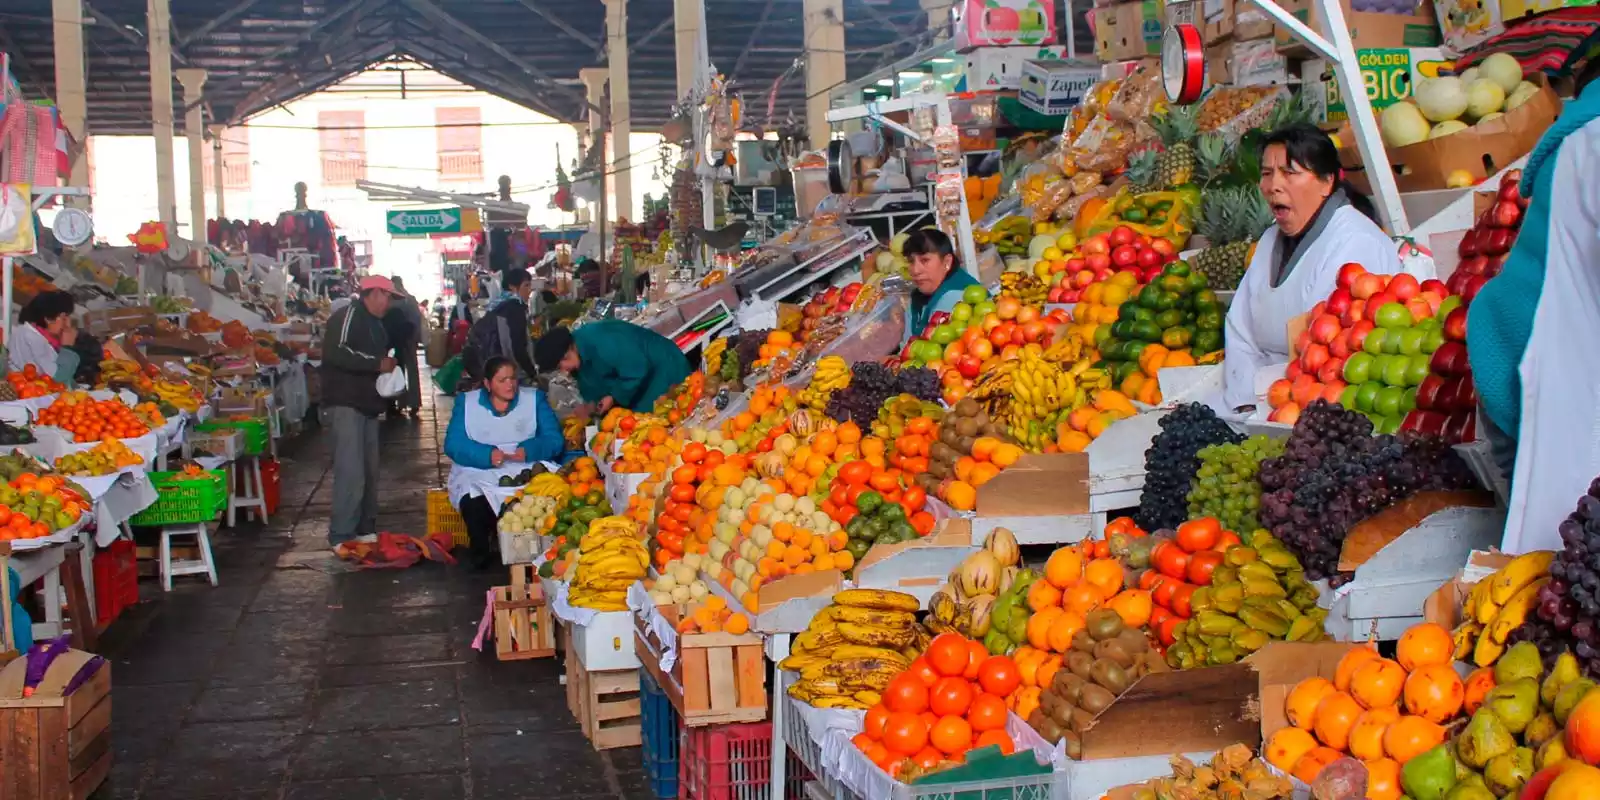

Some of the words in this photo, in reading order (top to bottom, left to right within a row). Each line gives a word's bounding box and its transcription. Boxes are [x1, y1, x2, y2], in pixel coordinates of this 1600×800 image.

[1359, 54, 1408, 66] GOLDEN
[1361, 68, 1410, 100] BIO
[402, 215, 443, 225] SALIDA
